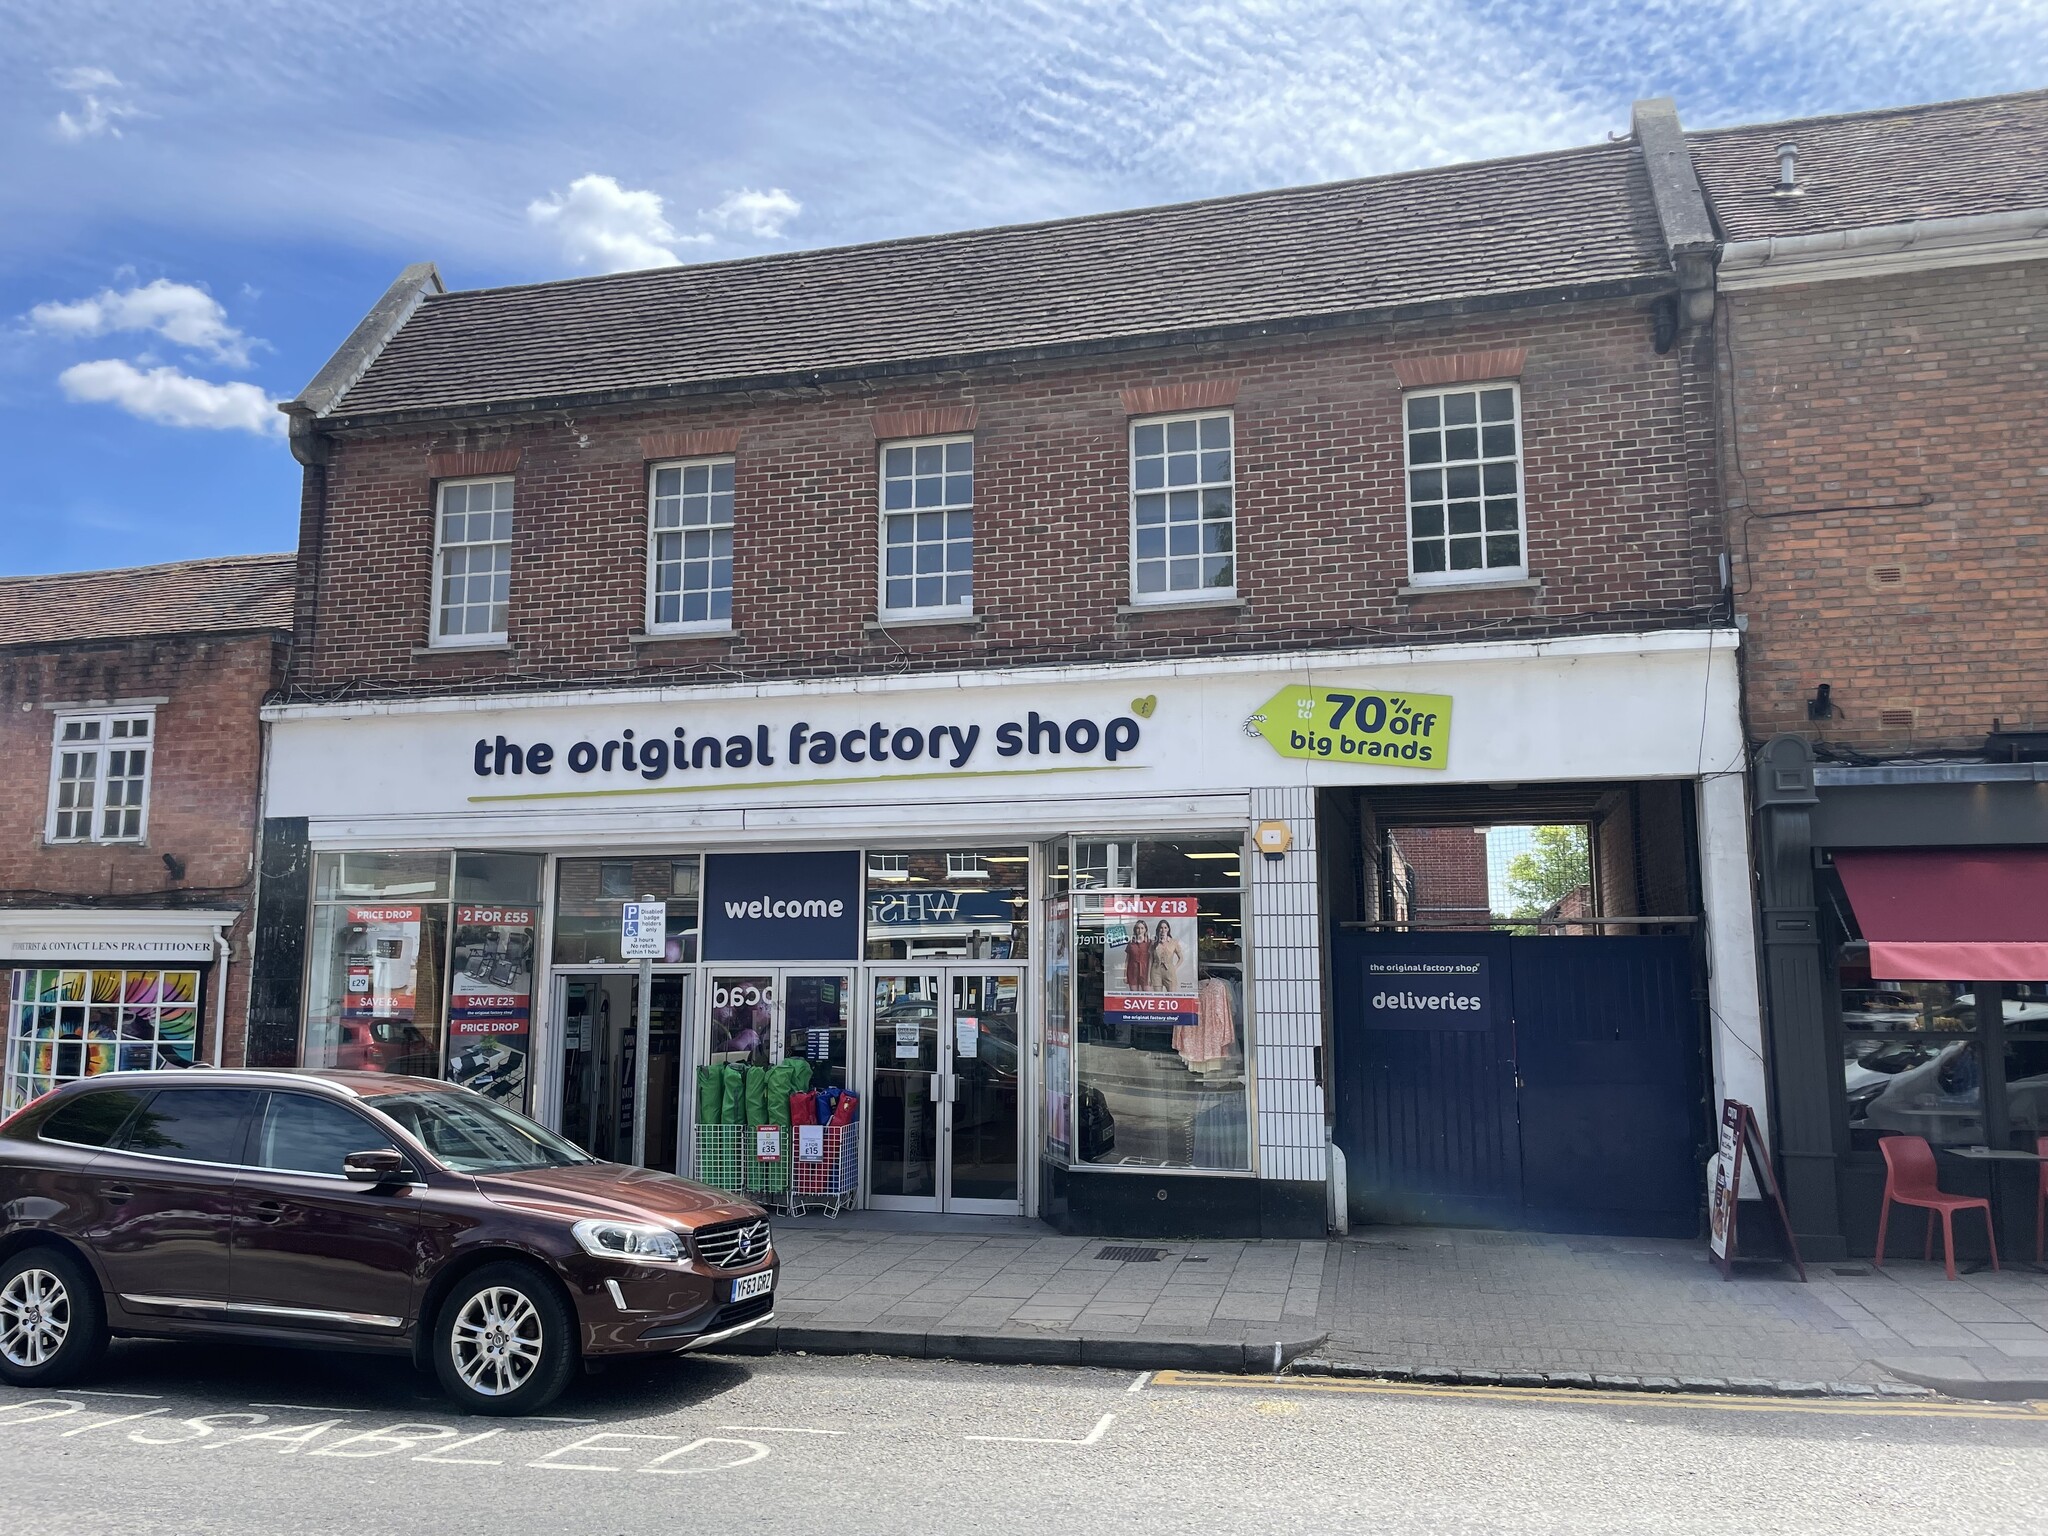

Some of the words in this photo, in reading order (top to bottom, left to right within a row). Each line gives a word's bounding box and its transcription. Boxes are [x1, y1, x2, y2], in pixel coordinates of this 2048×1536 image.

[1297, 698, 1316, 710] up
[1297, 708, 1312, 719] to
[1389, 712, 1437, 737] off
[473, 735, 554, 776] the
[567, 724, 775, 781] original
[788, 721, 981, 769] factory
[996, 711, 1140, 762] shop
[1290, 729, 1332, 757] big
[1340, 734, 1433, 762] brands
[724, 895, 844, 919] welcome
[1114, 900, 1156, 914] ONLY
[1160, 900, 1188, 914] £18
[357, 910, 384, 919] PRICE
[385, 910, 413, 918] DROP
[464, 910, 472, 922] 2
[474, 911, 501, 922] FOR
[504, 912, 528, 922] £55
[42, 942, 47, 950] &
[49, 942, 90, 950] CONTACT
[92, 942, 118, 950] LENS
[122, 942, 210, 952] PRACTITIONER
[1370, 963, 1384, 972] the
[1386, 963, 1421, 972] original
[1422, 964, 1454, 972] factory
[1456, 964, 1478, 973] shop
[352, 979, 366, 987] £29
[360, 997, 385, 1006] SAVE
[386, 998, 398, 1006] £6
[468, 998, 494, 1006] SAVE
[496, 997, 514, 1006] £25
[1124, 1000, 1154, 1010] SAVE
[1158, 1000, 1178, 1010] £10
[1372, 992, 1481, 1010] deliveries
[460, 1024, 490, 1032] PRICE
[492, 1023, 520, 1032] DROP
[624, 1049, 634, 1085] 7
[738, 1278, 756, 1298] YF63
[0, 1398, 771, 1474] DISABLED
